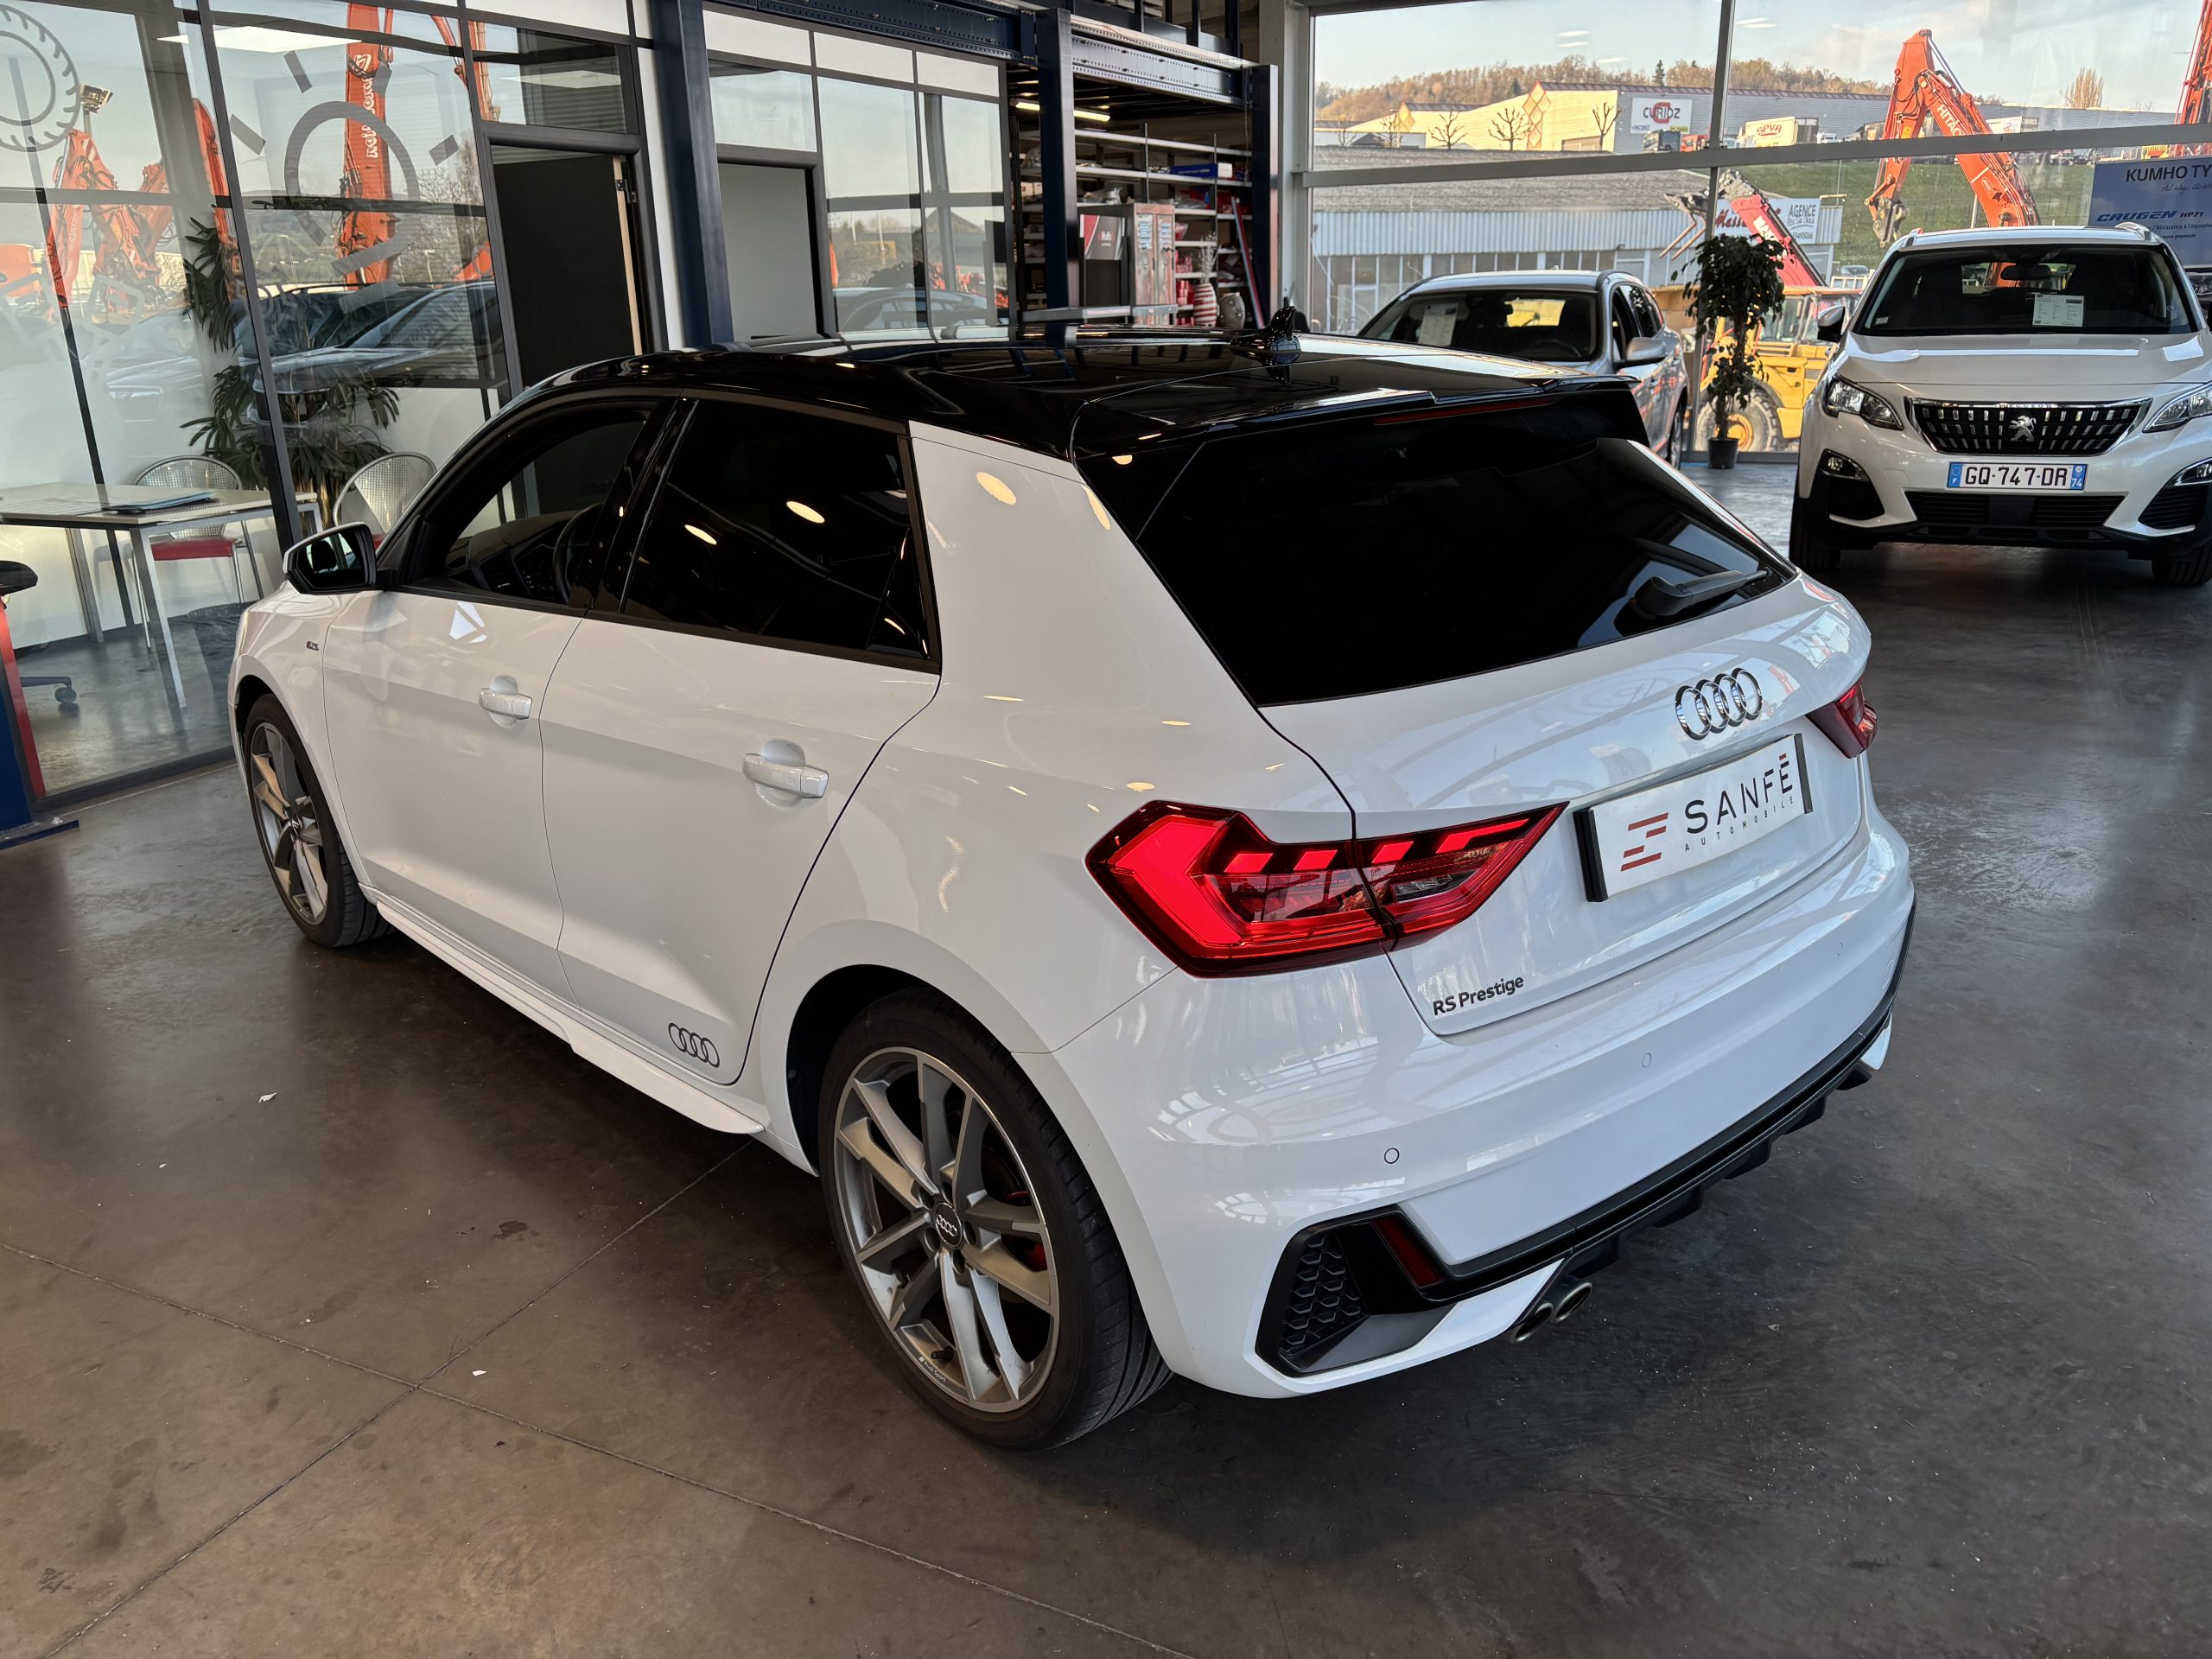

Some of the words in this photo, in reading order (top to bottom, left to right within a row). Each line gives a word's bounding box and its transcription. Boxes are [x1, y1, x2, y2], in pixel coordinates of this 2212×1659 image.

[1643, 106, 1681, 119] CURIOZ
[1936, 104, 1963, 137] HITAC
[2126, 165, 2188, 182] KUMHO
[2191, 164, 2212, 178] TY
[1789, 204, 1816, 217] AGENCE
[1965, 467, 2068, 486] GQ-747-DR
[2071, 478, 2082, 487] 74
[1685, 796, 1794, 852] AUTOMOBILE
[1433, 995, 1457, 1016] RS
[1459, 976, 1524, 1007] Prestige
